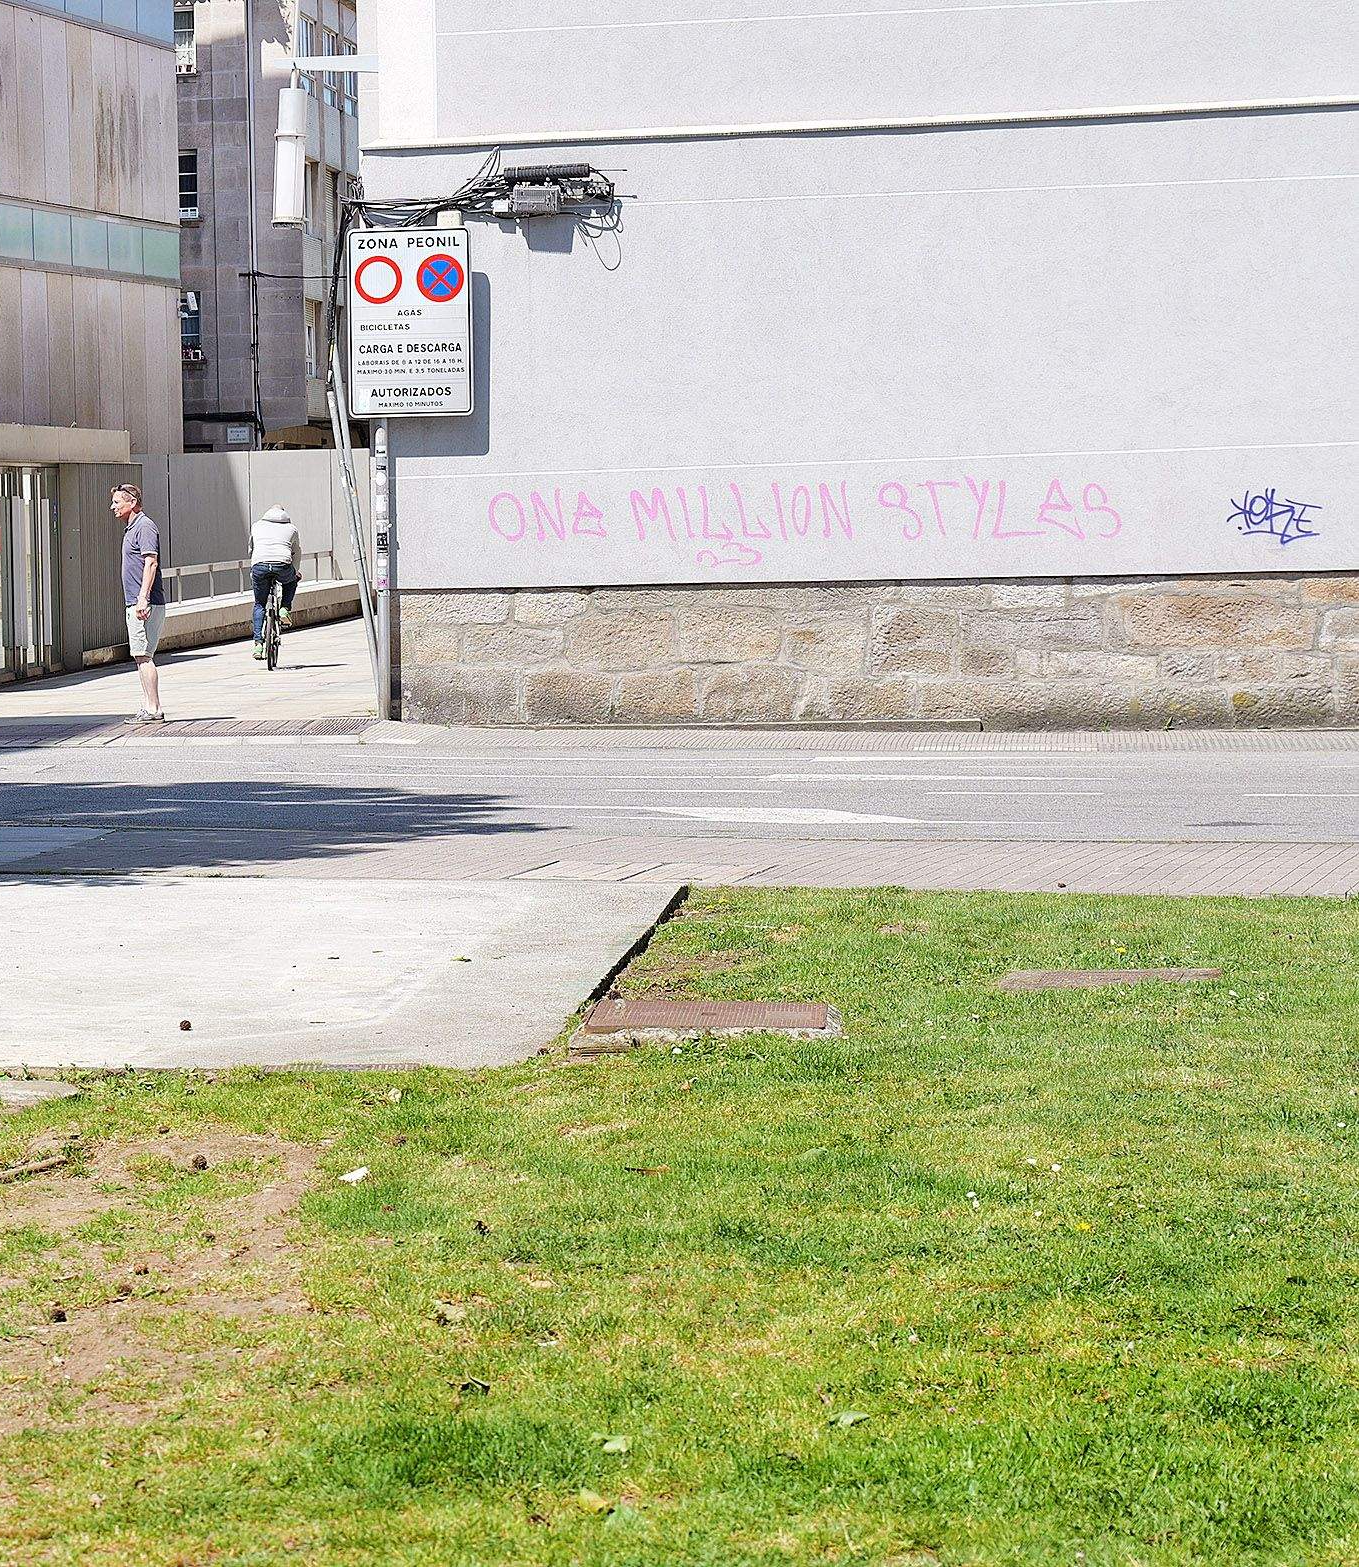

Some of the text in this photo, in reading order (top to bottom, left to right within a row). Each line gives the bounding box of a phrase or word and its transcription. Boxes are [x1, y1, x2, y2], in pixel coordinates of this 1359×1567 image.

[358, 236, 460, 249] ZONA PEONIL
[360, 323, 410, 331] BICICLETAS
[359, 342, 462, 354] CARGA E DESCARGA
[370, 387, 452, 398] AUTORIZADOS
[488, 475, 1122, 542] ONE MILLION STYLES
